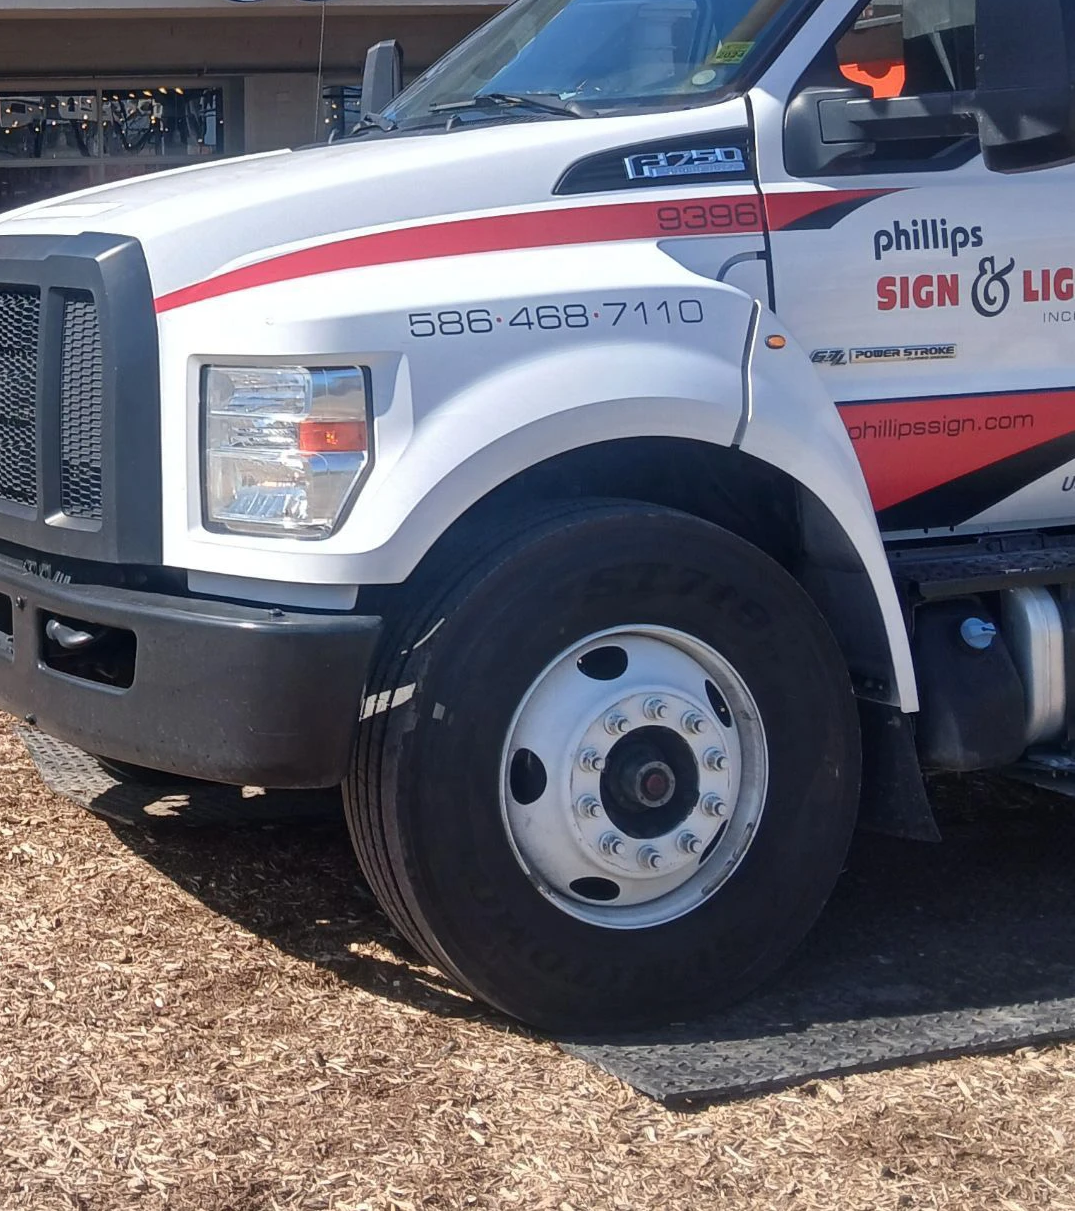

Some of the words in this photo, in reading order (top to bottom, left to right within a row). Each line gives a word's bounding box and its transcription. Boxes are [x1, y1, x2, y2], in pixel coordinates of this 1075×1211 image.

[657, 203, 758, 231] 9396
[874, 218, 984, 261] phillips
[876, 274, 960, 311] SIGN
[971, 256, 1015, 318] &
[1023, 267, 1075, 303] LIG
[1043, 311, 1075, 323] INC
[855, 349, 901, 359] POWER
[904, 346, 955, 357] STROKE
[848, 414, 1034, 440] phillipssign.com
